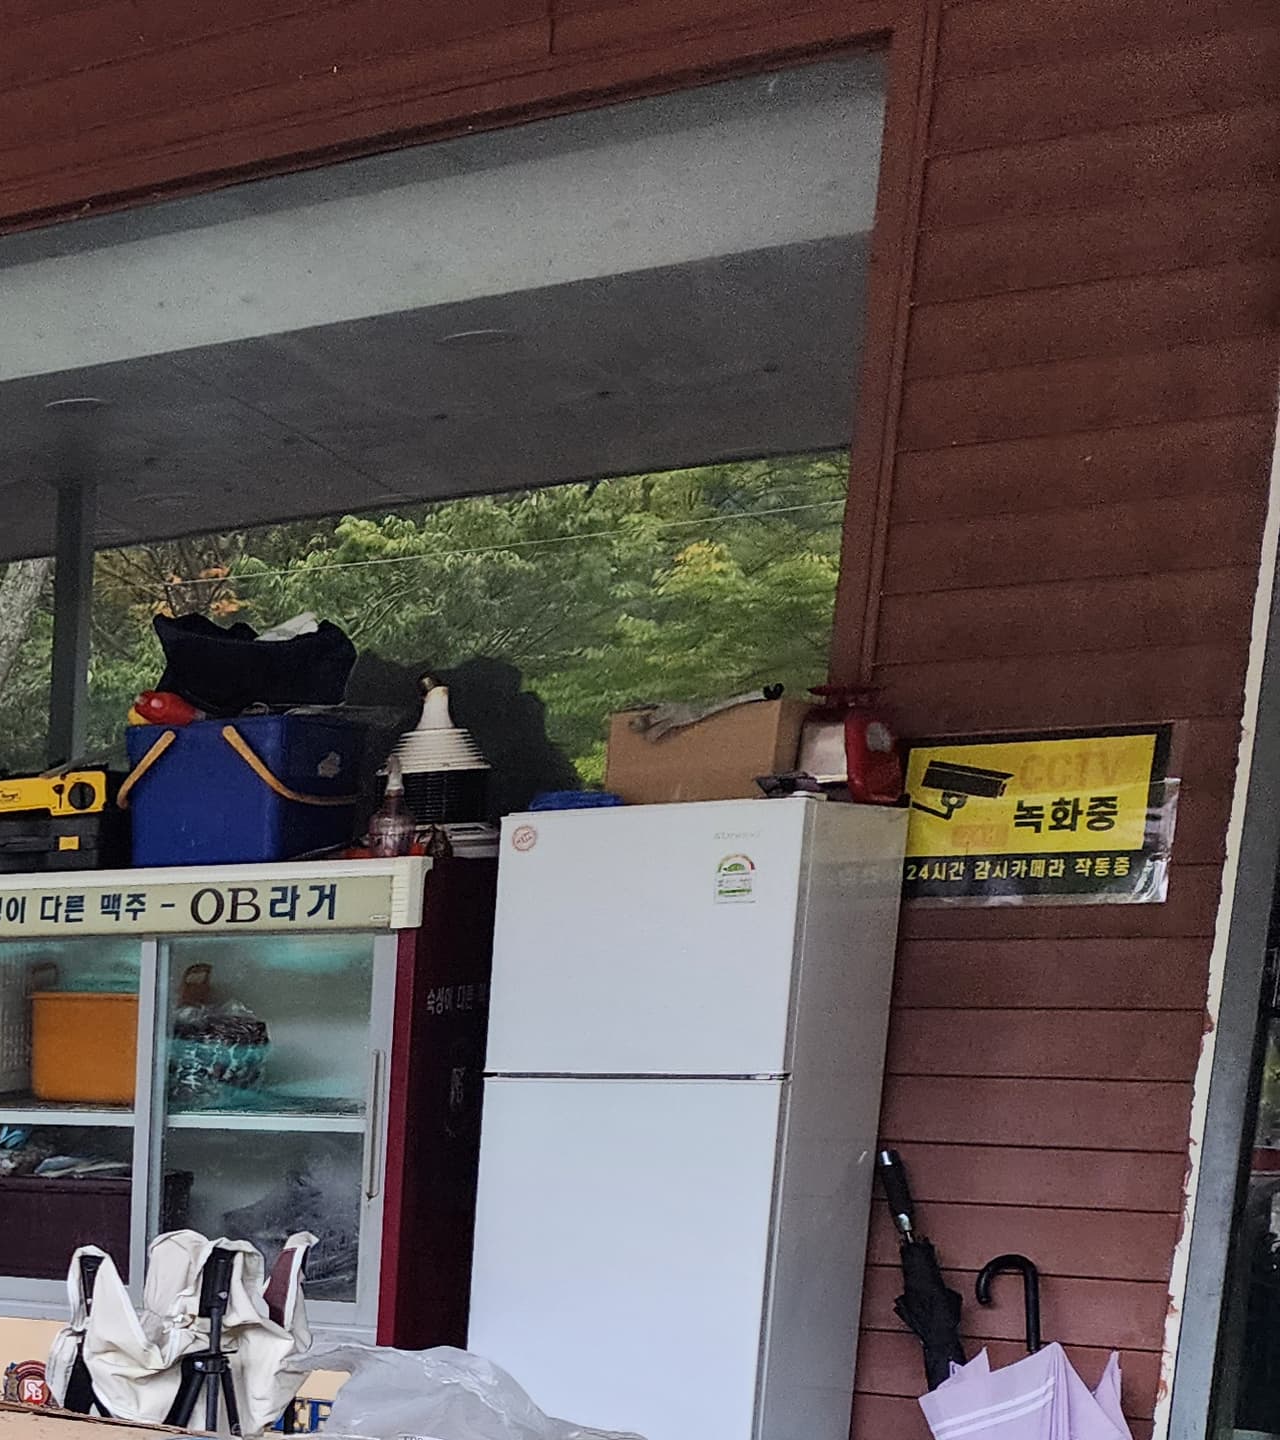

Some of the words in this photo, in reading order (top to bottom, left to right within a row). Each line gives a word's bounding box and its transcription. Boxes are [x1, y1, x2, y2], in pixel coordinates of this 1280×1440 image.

[1013, 796, 1119, 833] 녹화중
[907, 862, 965, 881] 24시간
[974, 859, 1066, 880] 감시카메라
[1074, 857, 1131, 878] 작동중
[40, 894, 85, 923] 다른
[100, 893, 147, 918] 맥주
